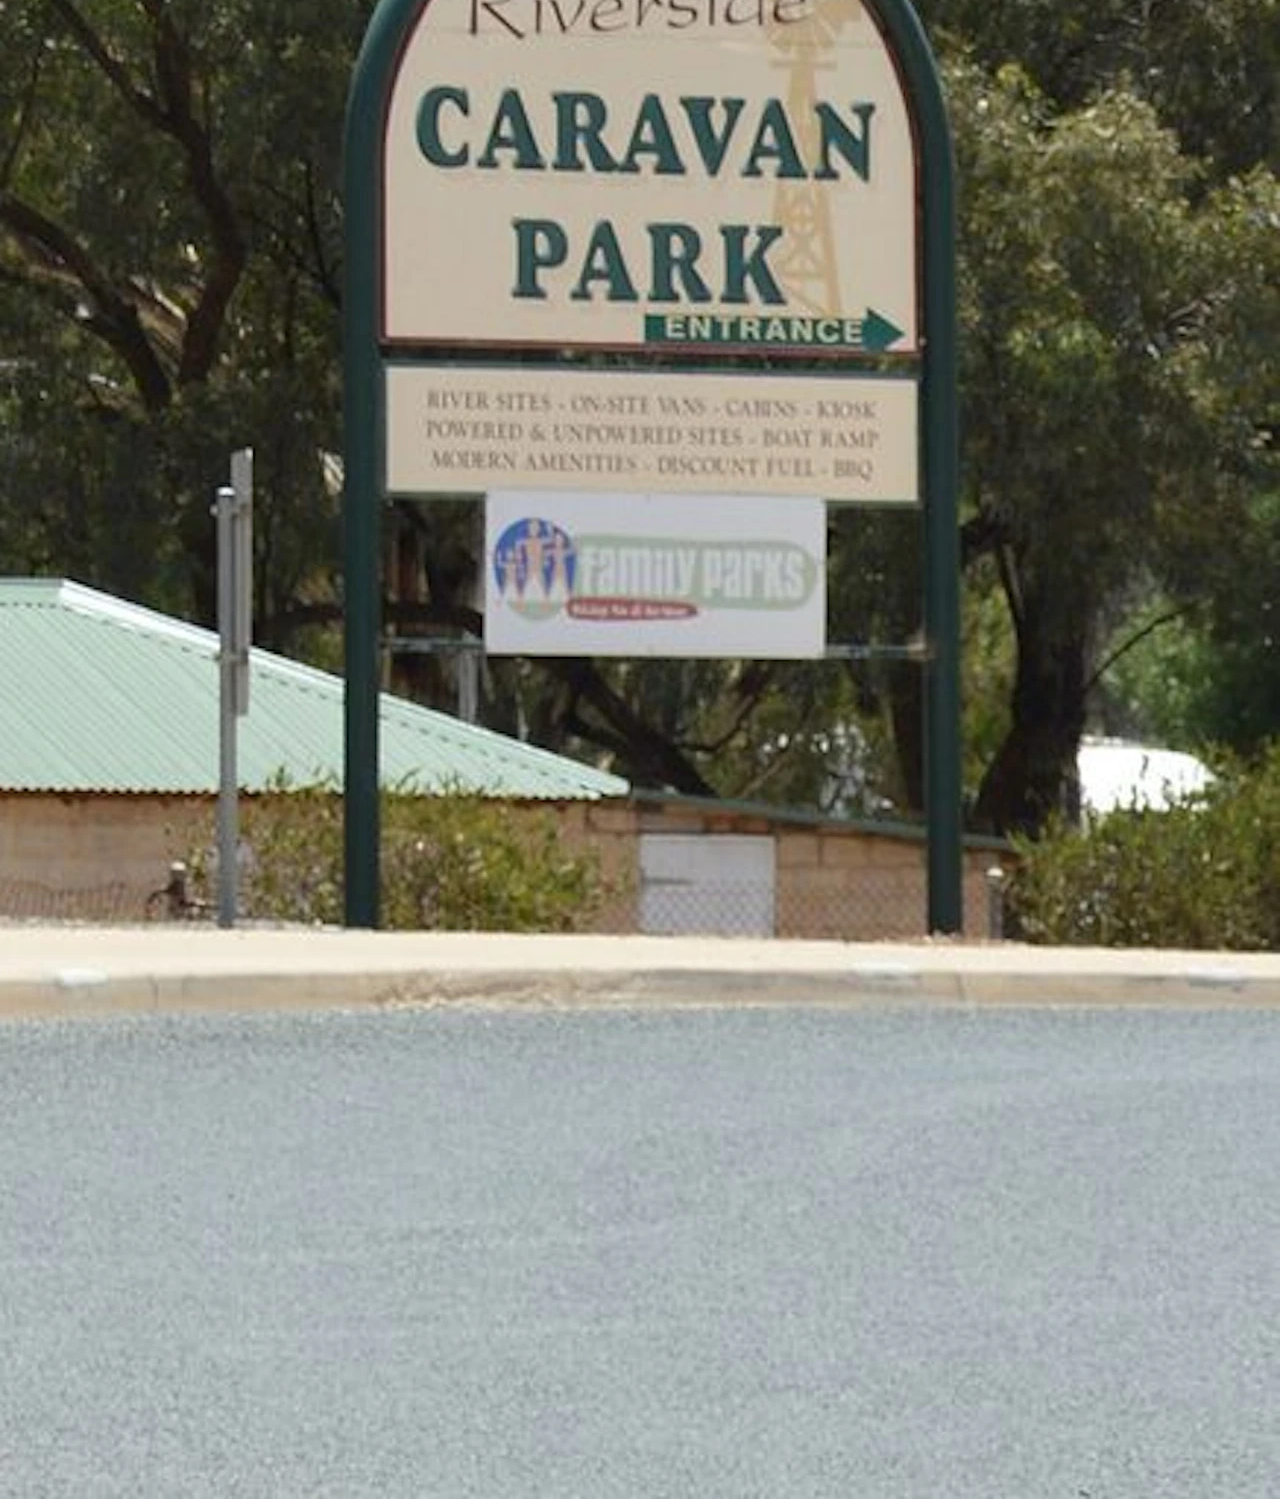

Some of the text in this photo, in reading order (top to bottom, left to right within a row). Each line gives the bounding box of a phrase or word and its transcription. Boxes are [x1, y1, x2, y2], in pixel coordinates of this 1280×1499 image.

[415, 85, 876, 183] CARAVAN
[511, 217, 788, 306] PARK
[665, 316, 862, 344] ENTRANCE
[426, 389, 489, 410] RIVER
[496, 391, 551, 412] SITES
[657, 395, 706, 415] VANS
[725, 397, 796, 417] CABINS
[817, 399, 877, 419] KIOSK
[426, 419, 523, 441] POWERED
[530, 422, 546, 442] &
[553, 423, 682, 445] UNPOWERED
[687, 426, 743, 446] SITES
[763, 429, 812, 448] BOAT
[820, 429, 879, 449] RAMP
[431, 450, 516, 471] MODERN
[526, 452, 638, 473] AMENITIES
[657, 455, 759, 477] DISCOUNT
[766, 458, 814, 477] FUEL
[833, 459, 873, 481] BBQ
[580, 545, 806, 600] family parks
